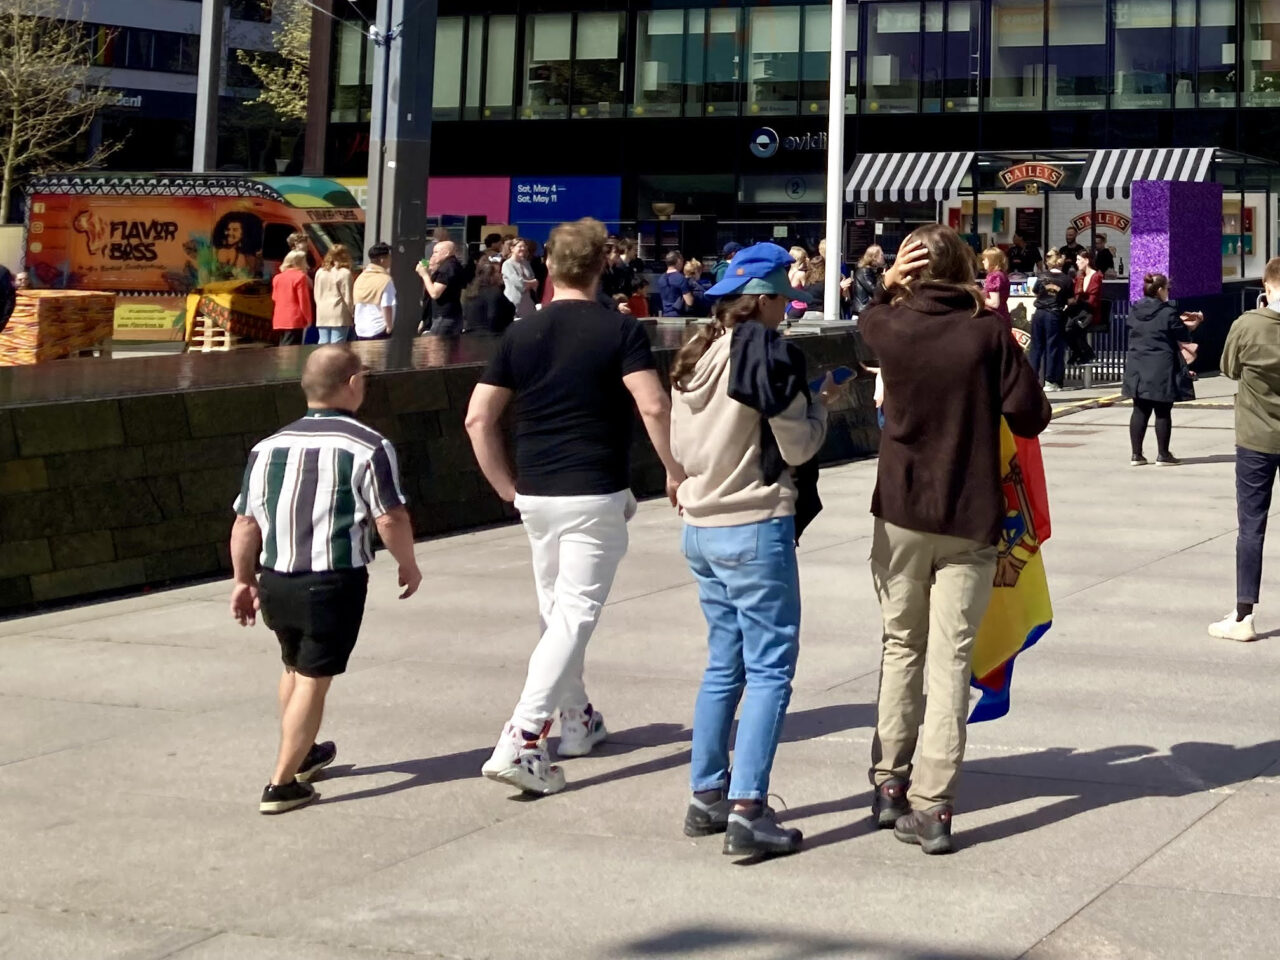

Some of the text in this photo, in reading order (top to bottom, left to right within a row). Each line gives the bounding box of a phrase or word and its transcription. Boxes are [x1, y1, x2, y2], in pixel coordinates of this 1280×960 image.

[1004, 166, 1060, 183] BAILEYS
[517, 184, 532, 193] Sat,
[533, 184, 550, 194] May
[551, 184, 557, 193] 4
[517, 194, 557, 204] Sat, May 11
[1076, 213, 1127, 228] BALEYS
[109, 219, 178, 242] FLAVOR
